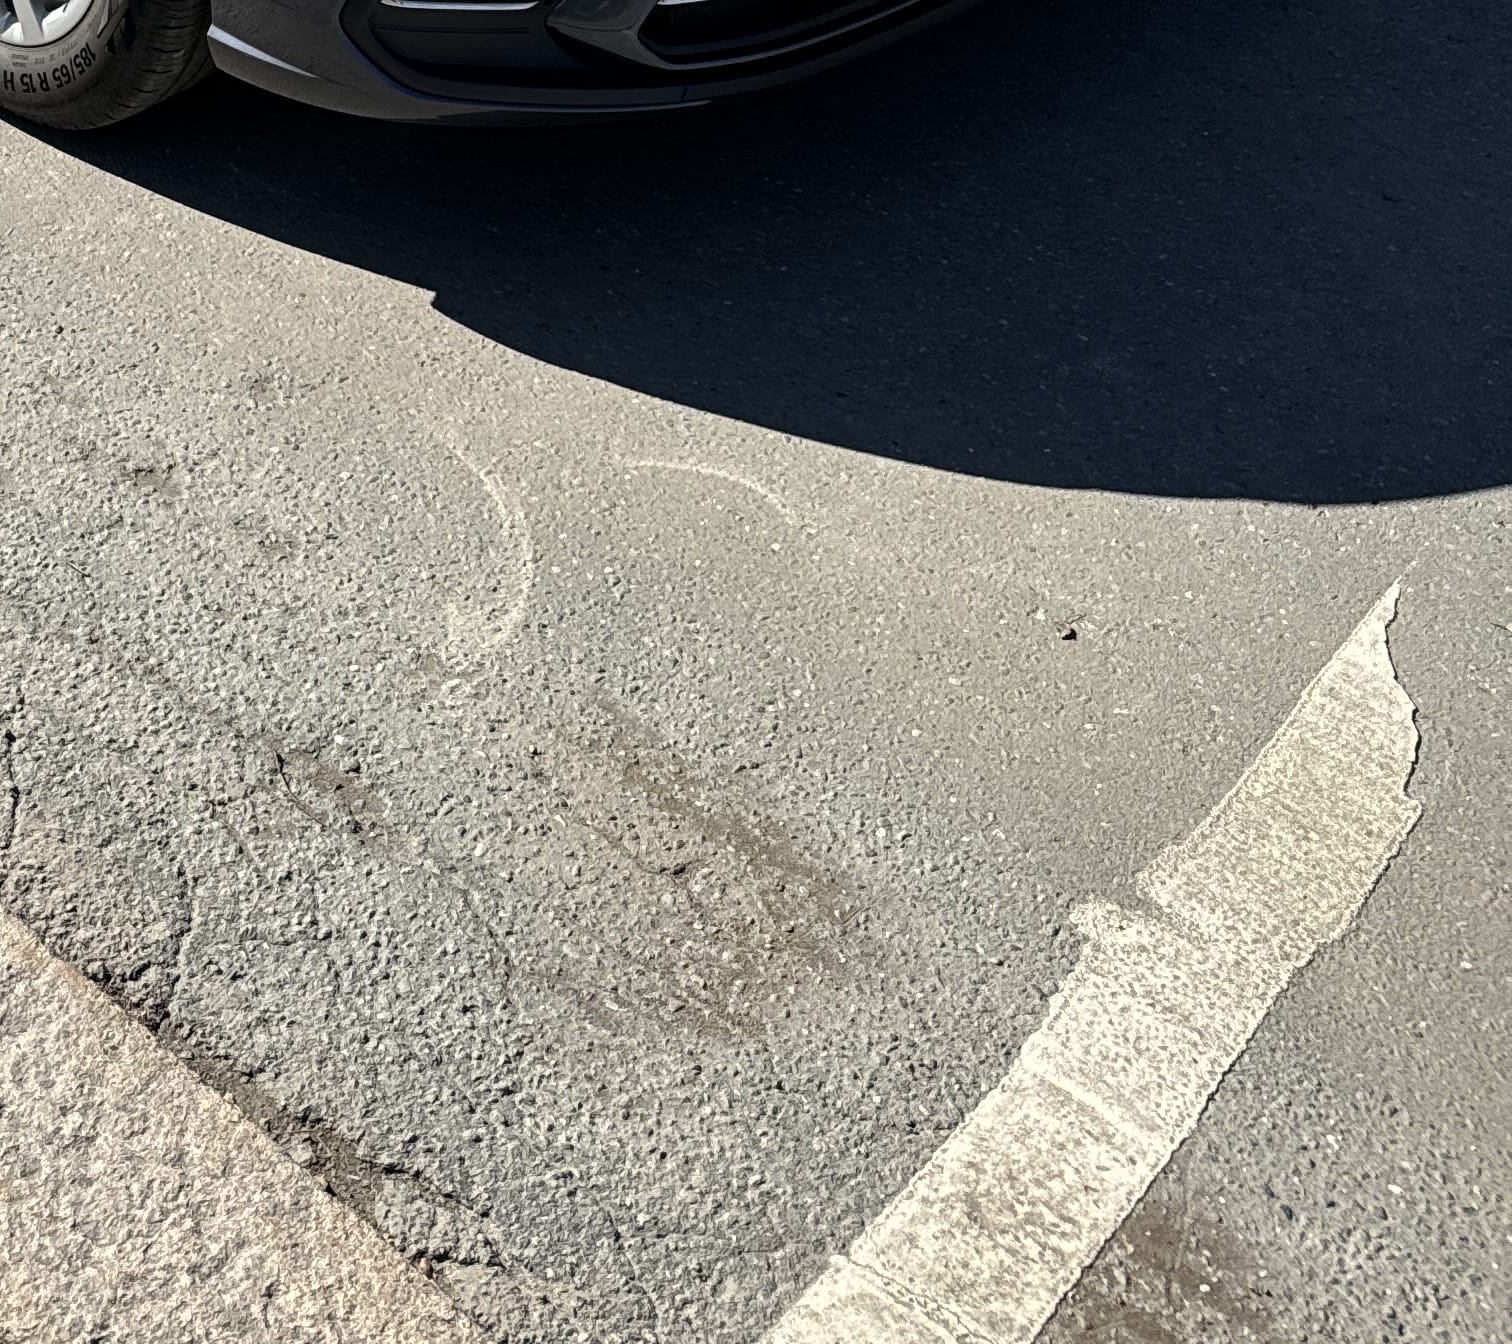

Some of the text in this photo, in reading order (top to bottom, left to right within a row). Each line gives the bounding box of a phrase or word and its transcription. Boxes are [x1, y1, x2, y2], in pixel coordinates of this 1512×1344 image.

[52, 41, 97, 89] 185/65
[3, 69, 17, 92] H
[19, 73, 37, 93] 15
[37, 71, 51, 92] R
